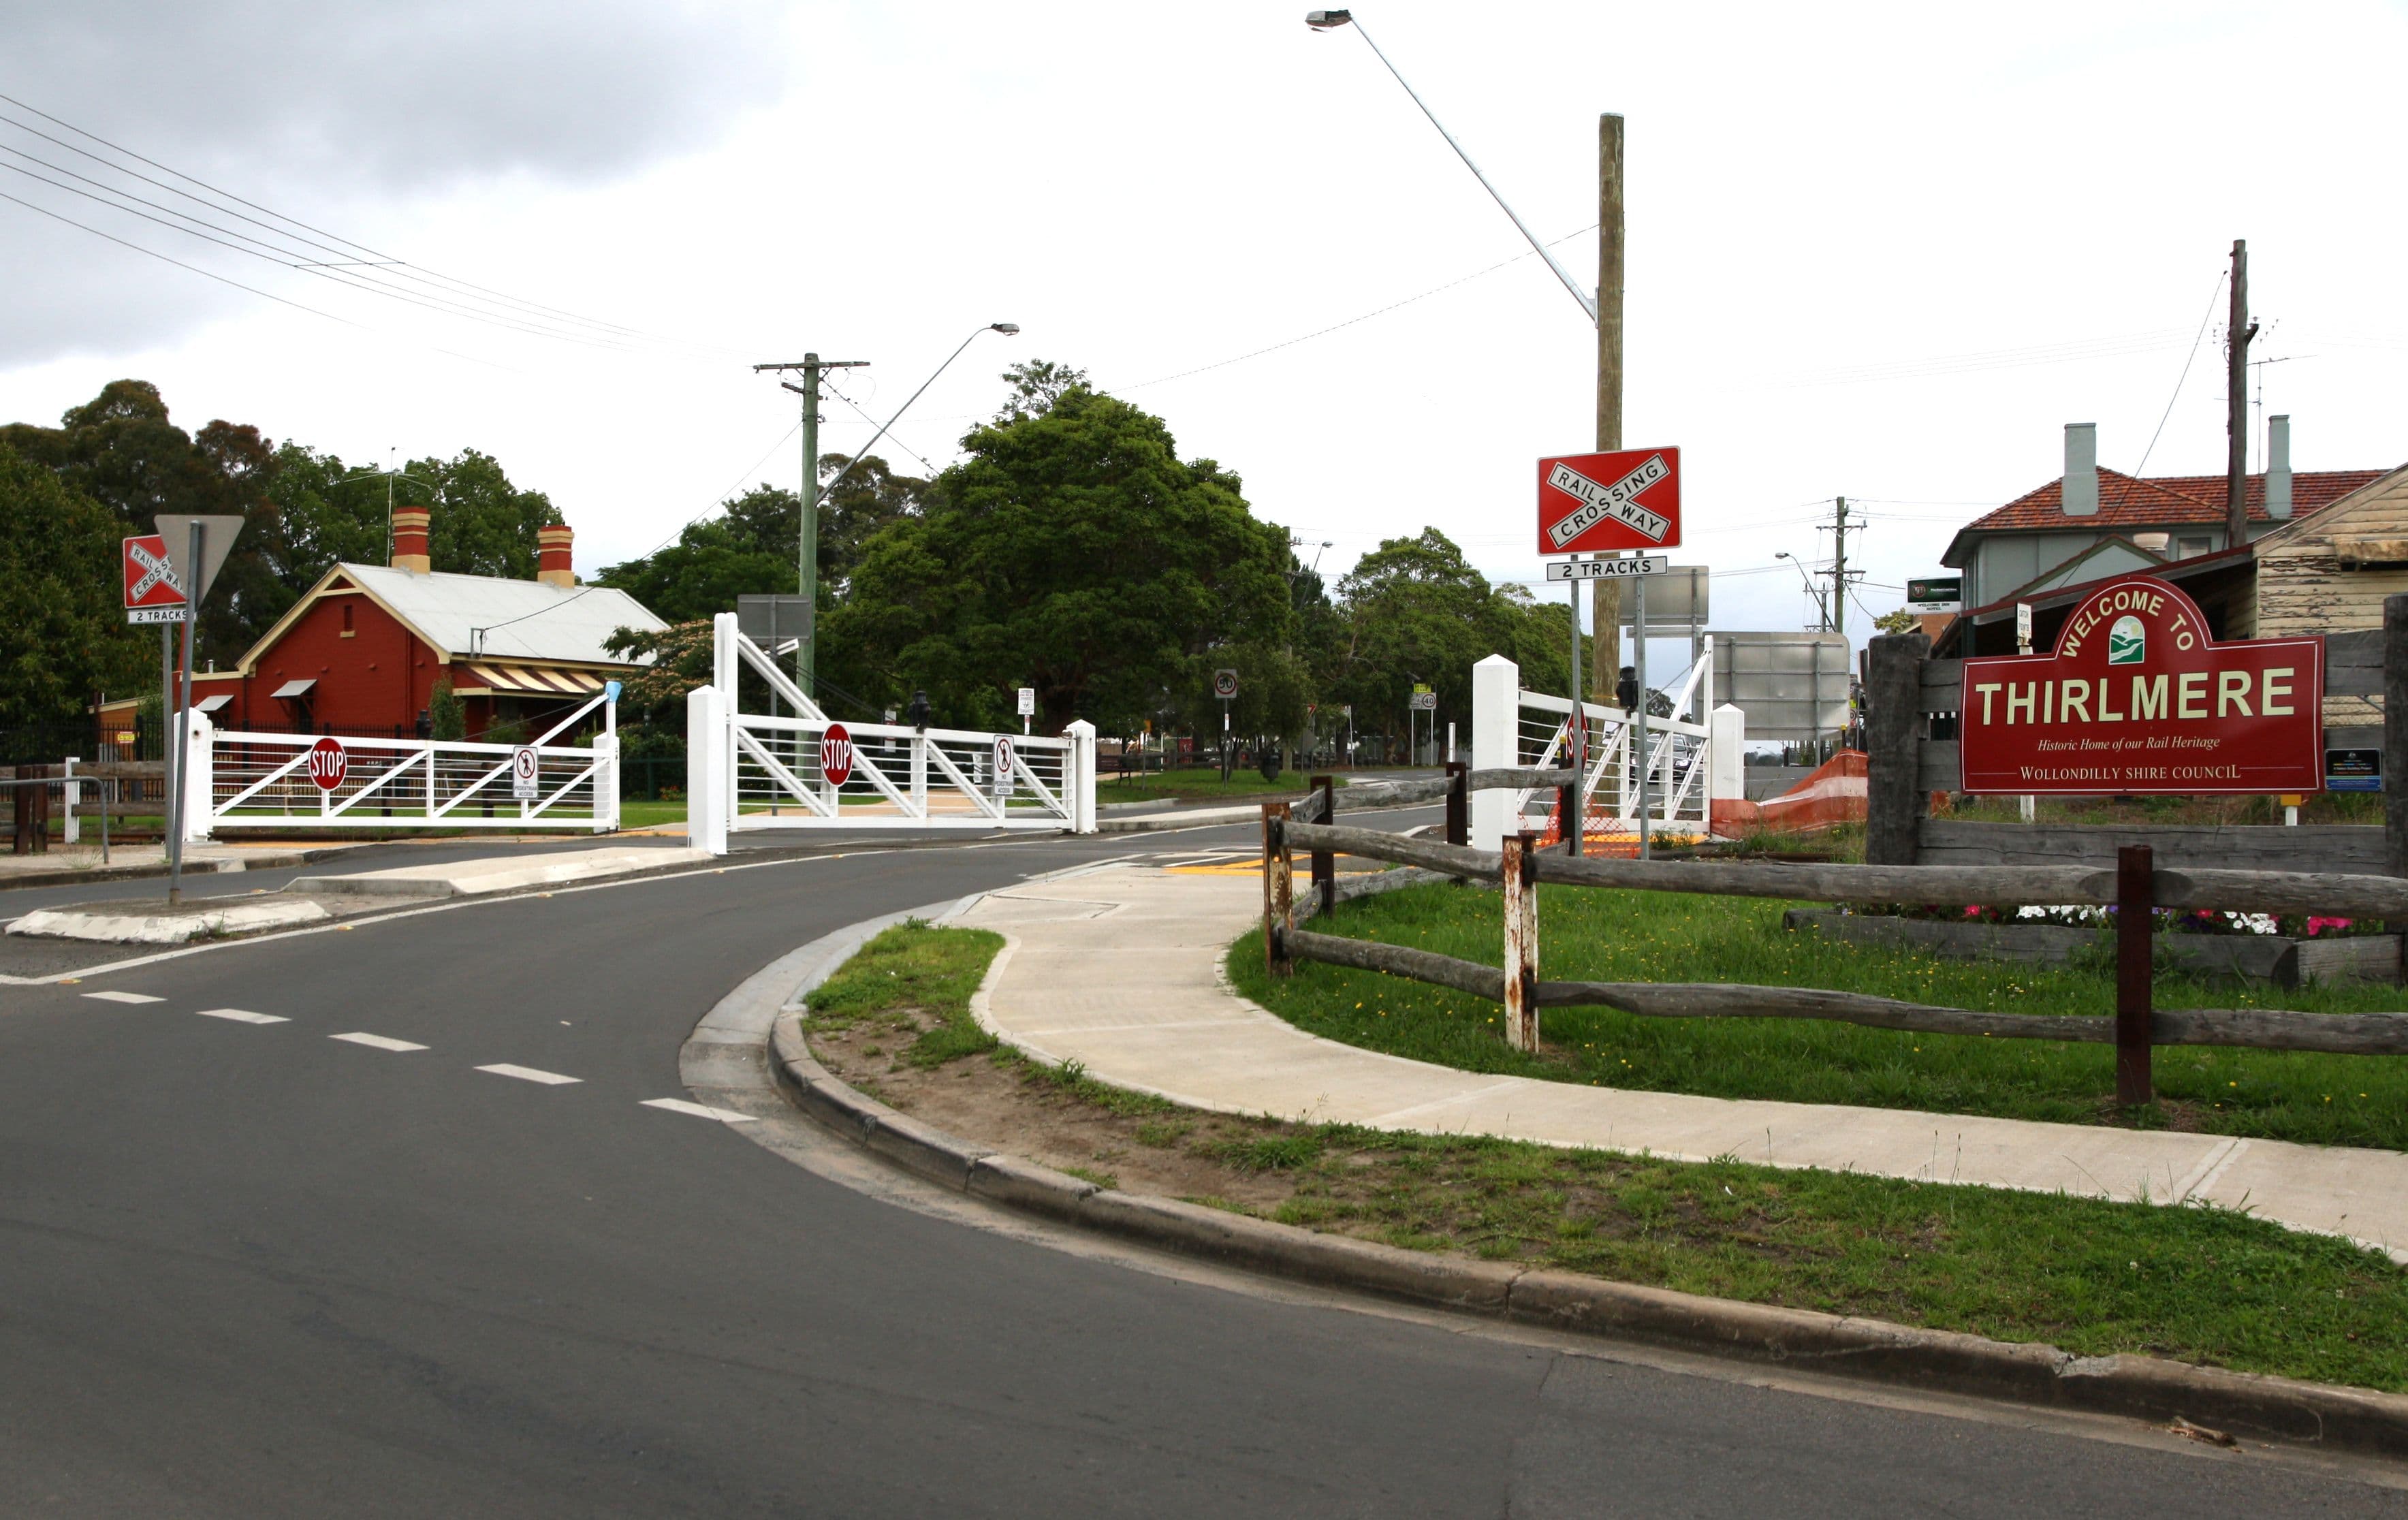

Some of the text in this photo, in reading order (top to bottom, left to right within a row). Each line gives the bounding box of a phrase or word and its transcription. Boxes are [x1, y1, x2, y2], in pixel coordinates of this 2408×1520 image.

[1558, 471, 1660, 531] RAIL WAY
[1561, 464, 1658, 537] CROSSING
[134, 548, 183, 590] RAIL WA
[136, 556, 172, 595] CROSSI
[1563, 560, 1651, 577] 2 TRACKS
[137, 613, 143, 622] 2
[2062, 590, 2193, 657] WELCOME TO
[1219, 678, 1233, 689] 50
[1975, 667, 2295, 726] THIRLMERE
[823, 739, 850, 770] STOP
[1568, 726, 1587, 757] SP
[2038, 735, 2221, 753] Historic Home of our Rail Heritage
[312, 750, 344, 777] STOP
[2020, 764, 2242, 780] WOLLONDILLY SHIRE COUNCIL
